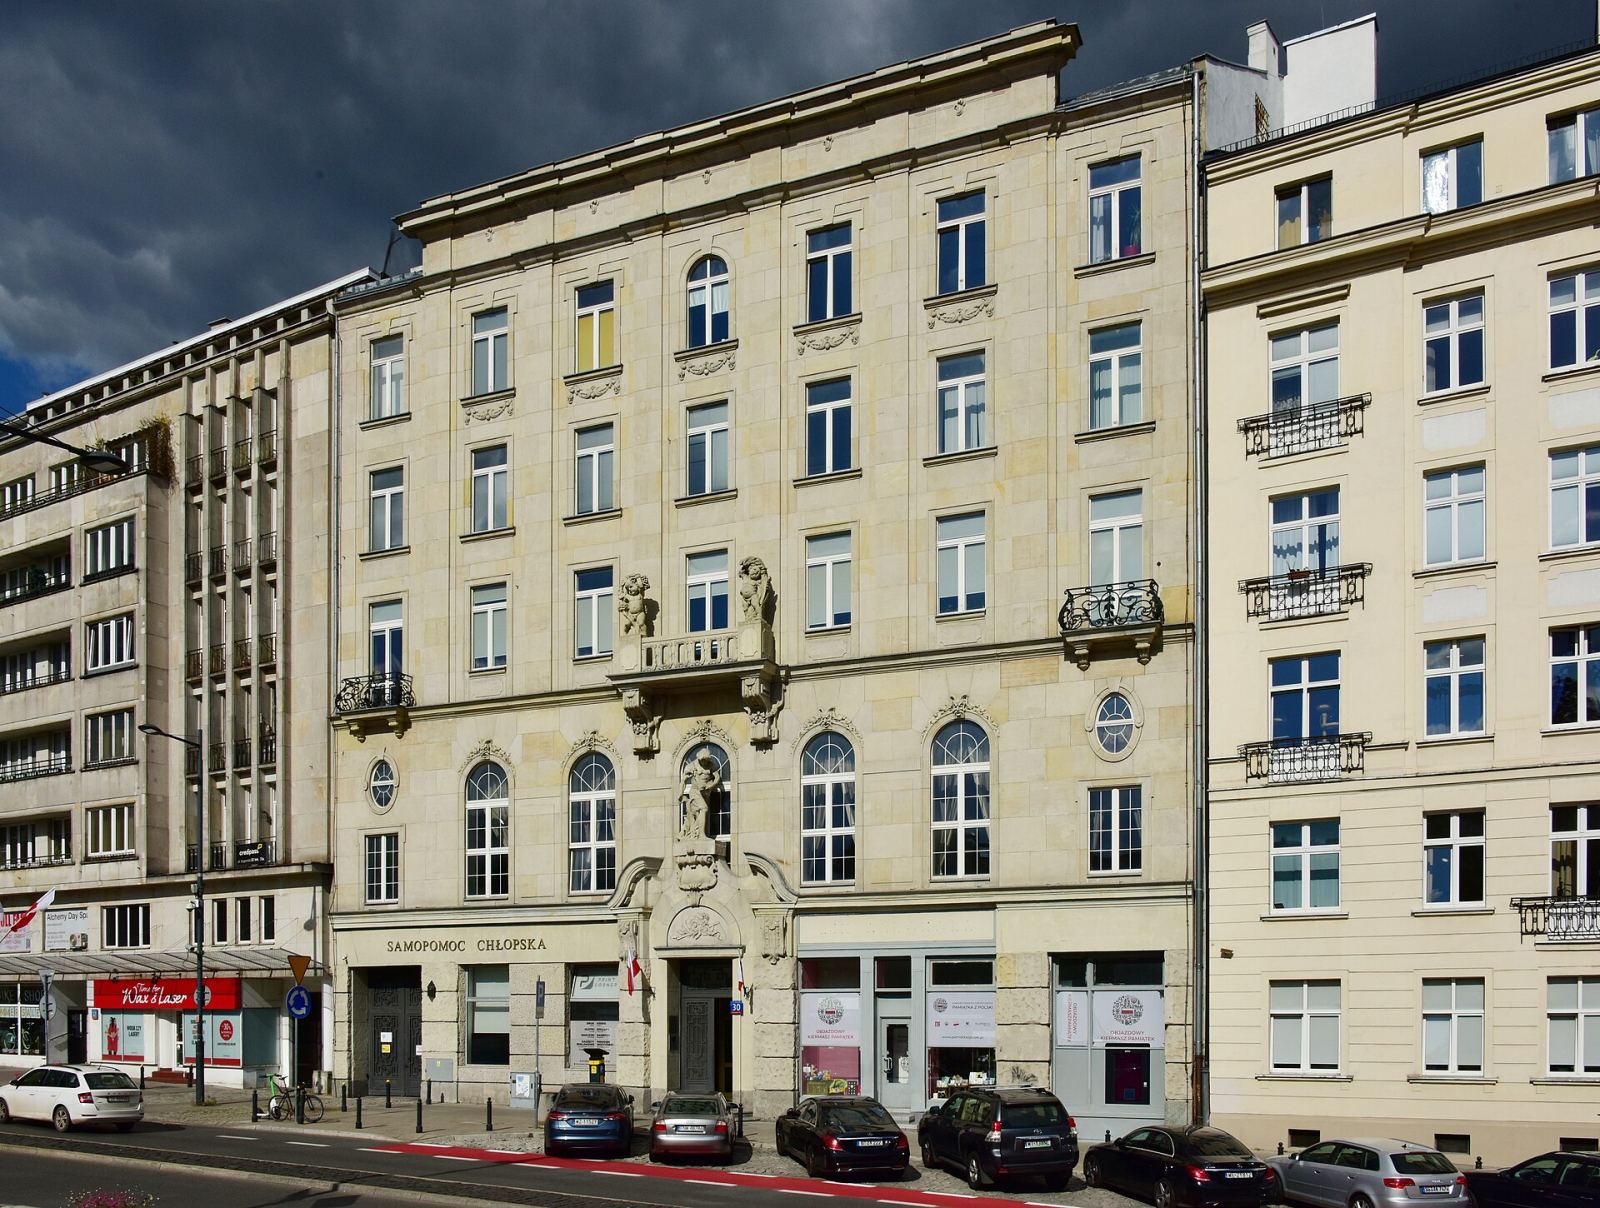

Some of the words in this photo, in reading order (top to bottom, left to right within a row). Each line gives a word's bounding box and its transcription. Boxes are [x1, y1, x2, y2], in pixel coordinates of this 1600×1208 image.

[47, 913, 66, 921] Alchemy
[68, 912, 78, 920] Day
[387, 940, 466, 952] SAMOPOMOC
[477, 938, 547, 951] CHŁOPSKA
[122, 986, 149, 1004] Wax
[159, 986, 187, 1004] Laser
[732, 1003, 741, 1011] 30
